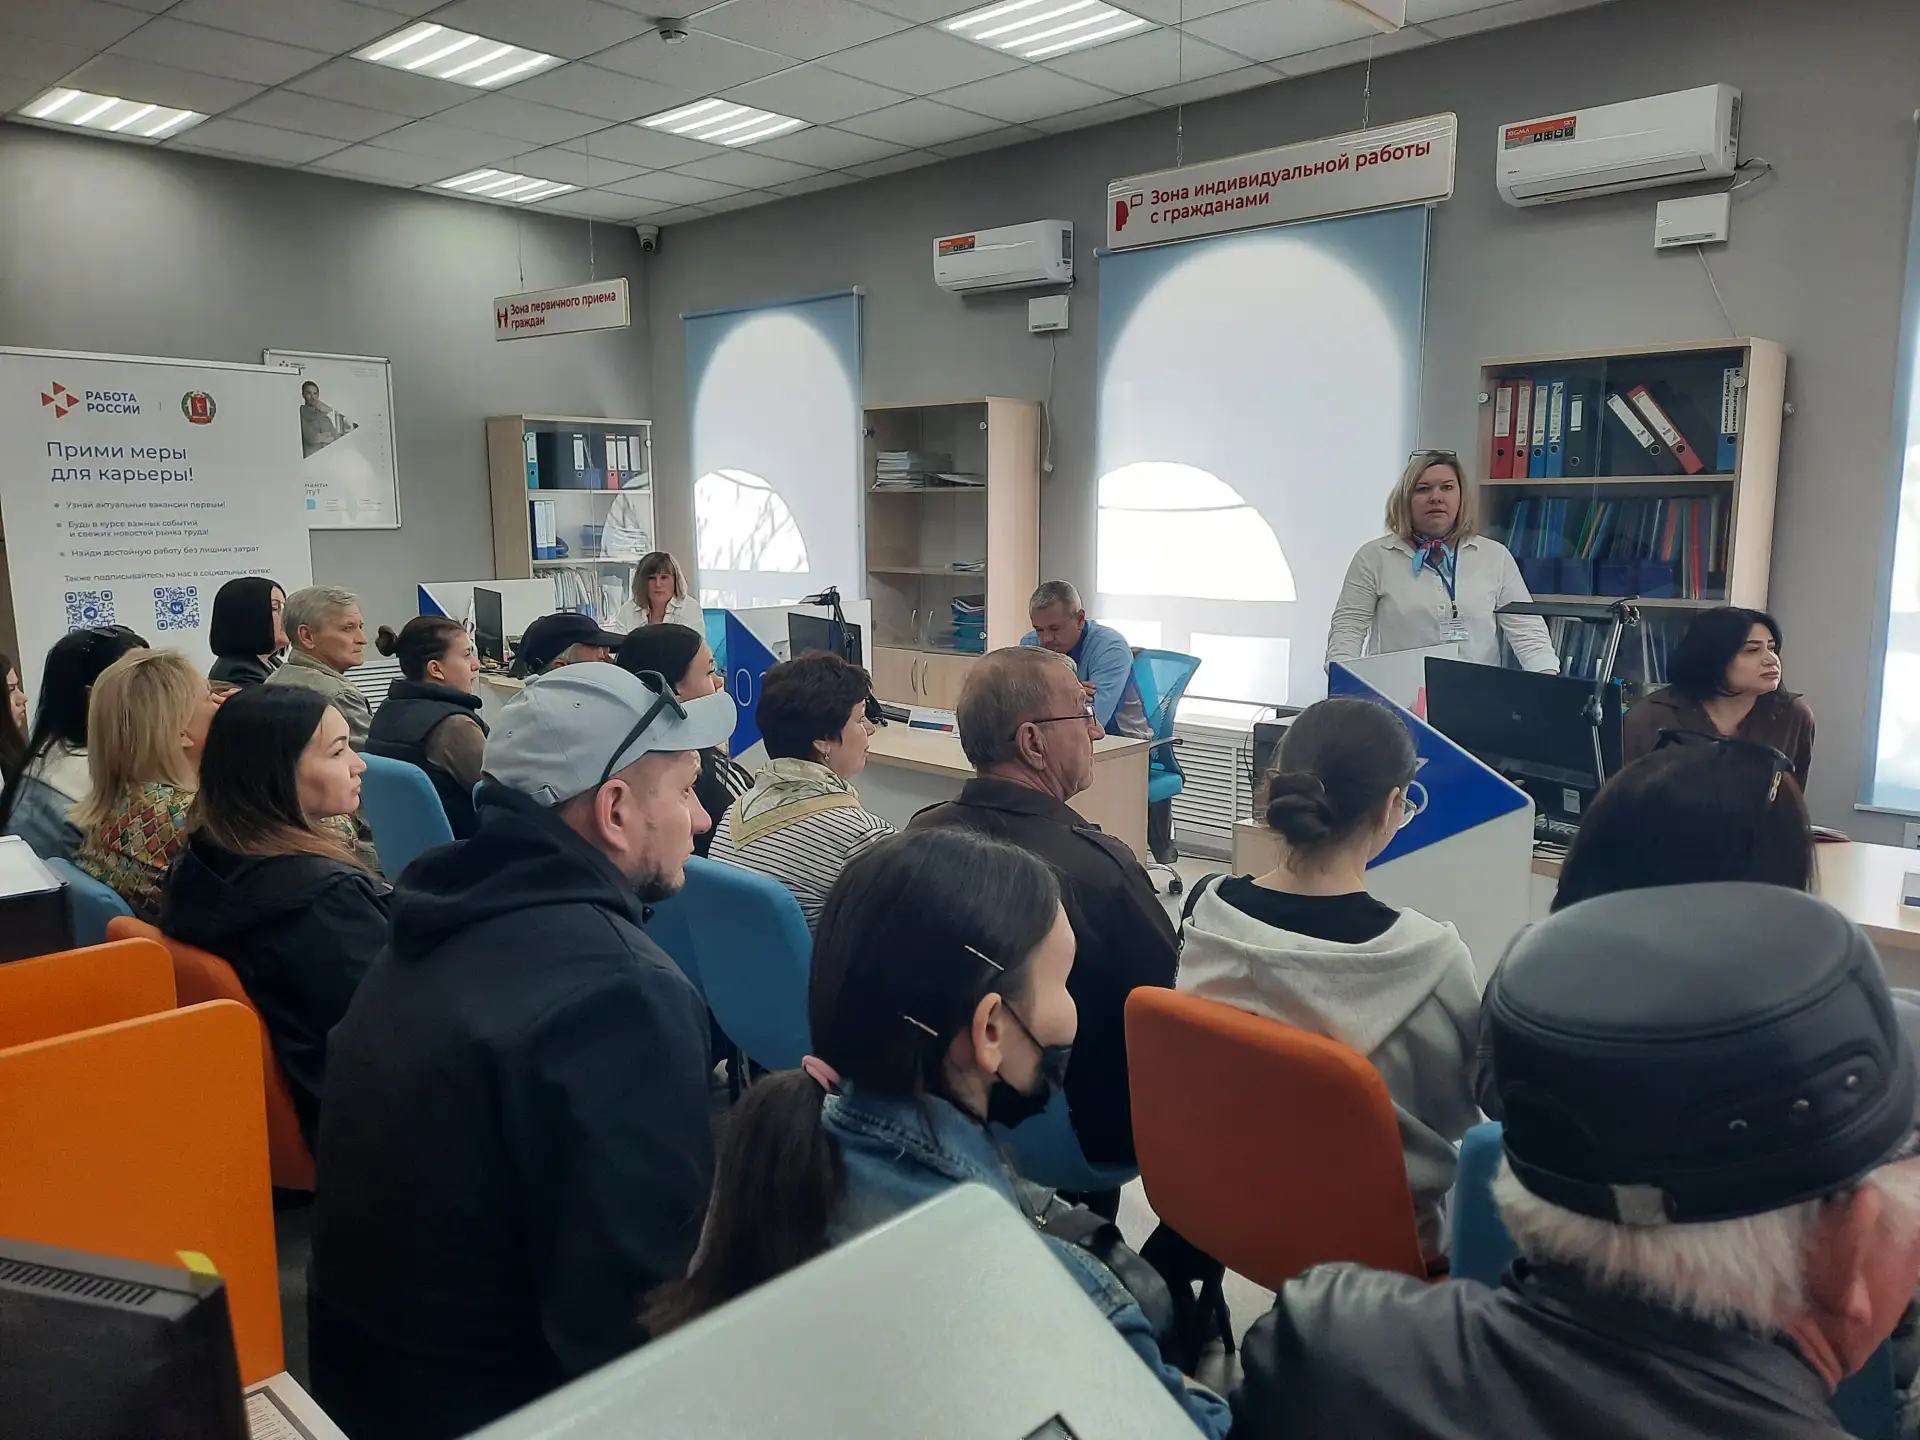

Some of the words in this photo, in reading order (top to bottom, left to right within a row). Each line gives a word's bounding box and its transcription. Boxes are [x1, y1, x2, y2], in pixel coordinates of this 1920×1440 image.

[1150, 187, 1189, 205] Зона
[1194, 154, 1349, 196] индивидуальной
[1355, 140, 1431, 171] работы
[1150, 212, 1158, 223] с
[1163, 192, 1270, 224] гражданами
[510, 304, 529, 315] Зона
[530, 297, 580, 314] первичного
[582, 291, 616, 307] приема
[511, 316, 545, 331] граждан
[85, 390, 137, 402] РАБОТА
[87, 403, 141, 414] РОССИИ
[47, 441, 124, 461] Прими
[131, 447, 187, 463] меры
[51, 467, 91, 482] для
[99, 467, 194, 484] карьеры!
[162, 519, 198, 527] событий
[103, 549, 152, 557] достойную
[153, 547, 182, 556] работу
[183, 546, 198, 554] без
